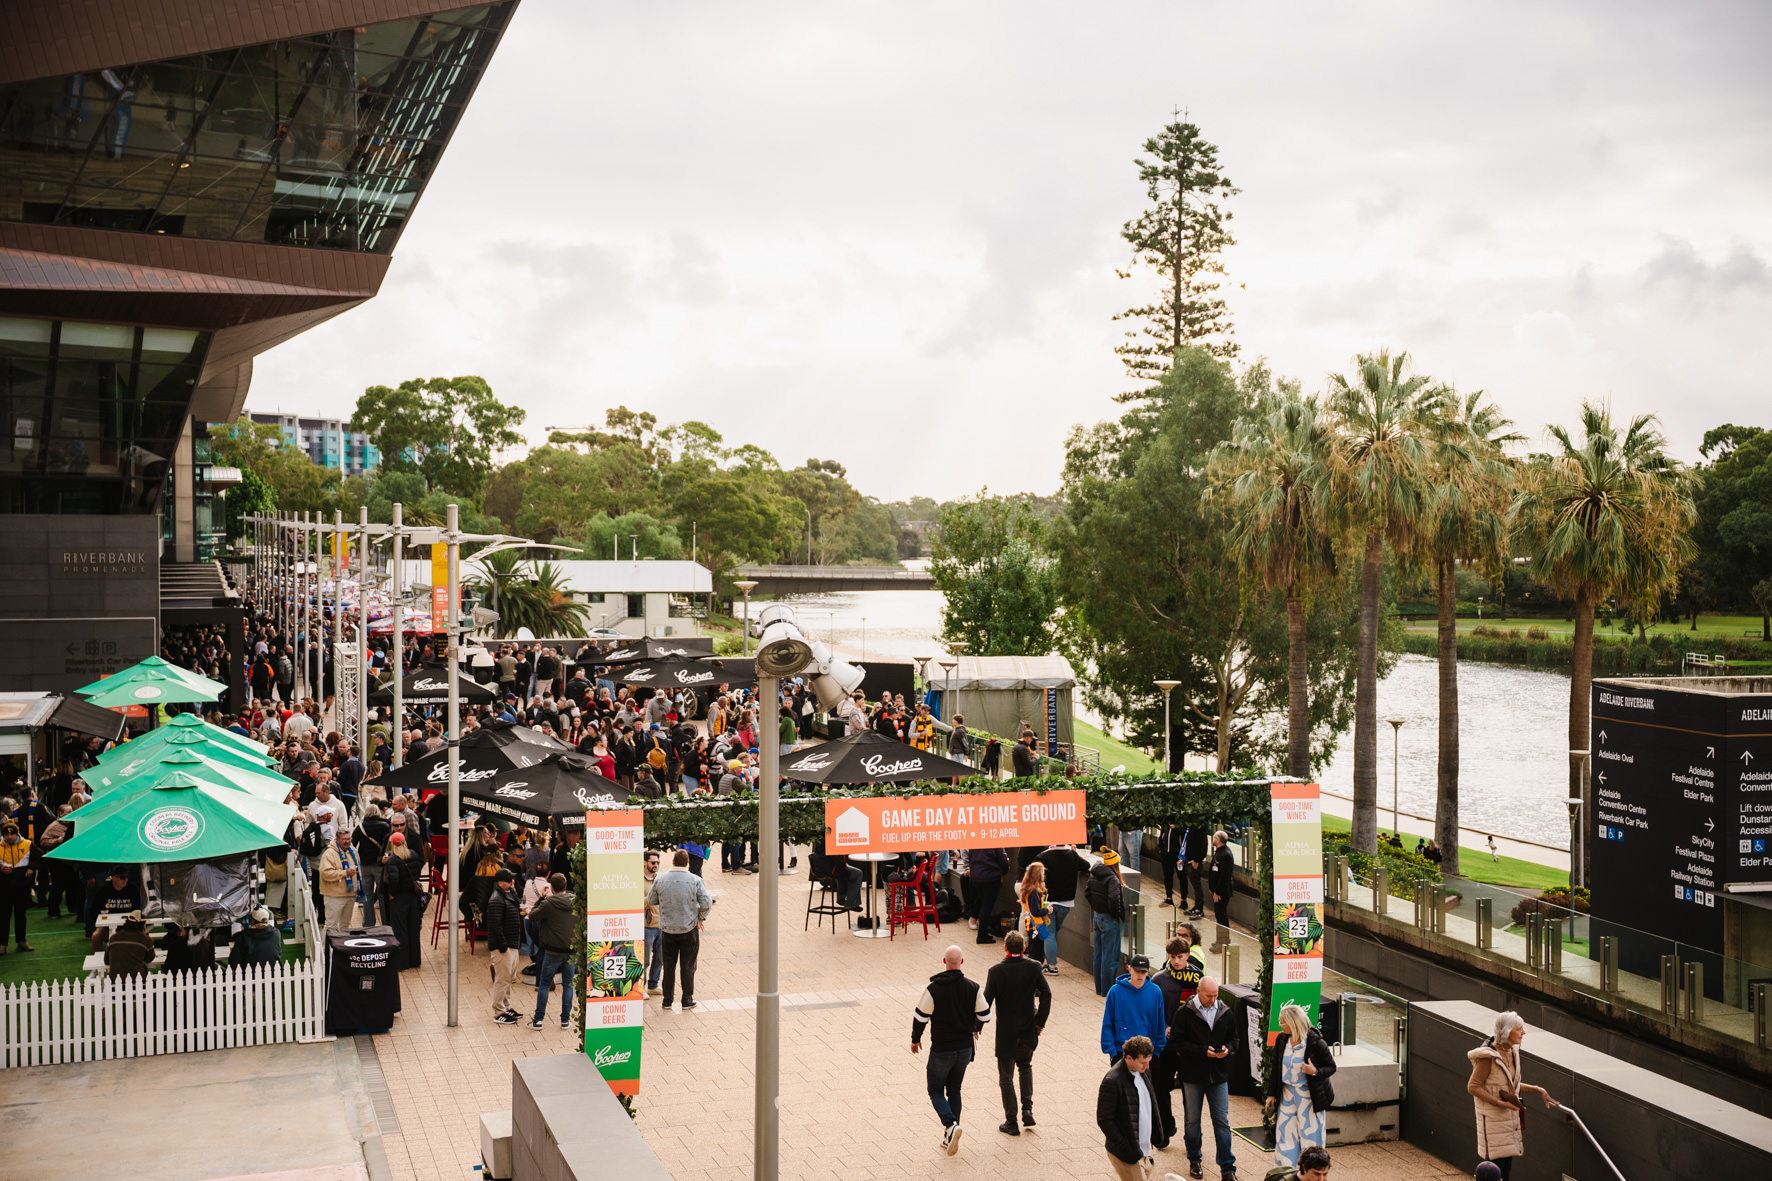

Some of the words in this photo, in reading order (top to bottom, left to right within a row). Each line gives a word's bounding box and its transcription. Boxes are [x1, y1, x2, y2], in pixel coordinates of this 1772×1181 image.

[64, 552, 145, 564] RIVERBANK
[674, 669, 714, 684] Coopers
[1600, 692, 1624, 706] ADELAIDE
[1625, 696, 1654, 710] RIVERBANK
[1048, 689, 1056, 743] RIVERBANK
[1742, 709, 1772, 720] ADELAI
[1599, 750, 1620, 760] Adelaide
[1622, 754, 1633, 763] Oval
[860, 754, 923, 777] Coopers
[1688, 765, 1714, 778] Adelaide
[1672, 773, 1693, 784] Festival
[1694, 777, 1714, 788] Centre
[573, 788, 615, 806] Coopers
[1599, 788, 1621, 799] Adelaide
[1684, 789, 1699, 800] Elder
[1700, 792, 1714, 803] Park
[463, 796, 485, 808] AUSTRALIAN
[486, 802, 501, 814] MADE
[502, 807, 521, 819] AUSTRALIAN
[521, 812, 540, 825] OWNED
[1278, 801, 1312, 810] GOOD-TIME
[1599, 798, 1627, 811] Convention
[1628, 804, 1646, 815] Centre
[1740, 804, 1752, 812] Lift
[882, 809, 920, 828] GAME
[926, 808, 953, 826] DAY
[958, 807, 974, 824] AT
[980, 805, 1018, 824] HOME
[1022, 803, 1075, 821] GROUND
[1286, 812, 1306, 820] WINES
[1599, 811, 1624, 824] Riverbank
[1625, 817, 1635, 826] Car
[1636, 819, 1648, 829] Park
[595, 830, 635, 840] GOOD-TIME
[882, 833, 900, 843] FUEL
[902, 832, 911, 842] UP
[913, 832, 926, 842] FOR
[928, 831, 942, 841] THE
[944, 830, 967, 840] FOOTY
[981, 829, 997, 839] 9-12
[999, 828, 1019, 838] APRIL
[604, 841, 628, 850] WINES
[1285, 840, 1310, 848] ALPHA
[1692, 835, 1714, 850] SkyCity
[1278, 848, 1291, 857] BOX
[1675, 846, 1697, 858] Festival
[1698, 850, 1714, 862] Plaza
[1740, 858, 1761, 866] Elder
[1687, 863, 1712, 876] Adelaide
[602, 874, 630, 882] ALPHA
[1671, 869, 1693, 884] Railway
[1694, 875, 1714, 888] Station
[620, 880, 638, 888] DICE
[1288, 881, 1308, 890] GREAT
[1286, 891, 1310, 900] SPIRITS
[604, 917, 627, 927] GREAT
[602, 928, 630, 938] SPIRITS
[361, 952, 388, 962] DEPOSIT
[1288, 962, 1308, 970] ICONIC
[1288, 971, 1307, 980] BEERS
[602, 1004, 626, 1014] ICONIC
[602, 1015, 626, 1024] BEERS
[595, 1045, 631, 1068] Coopers
